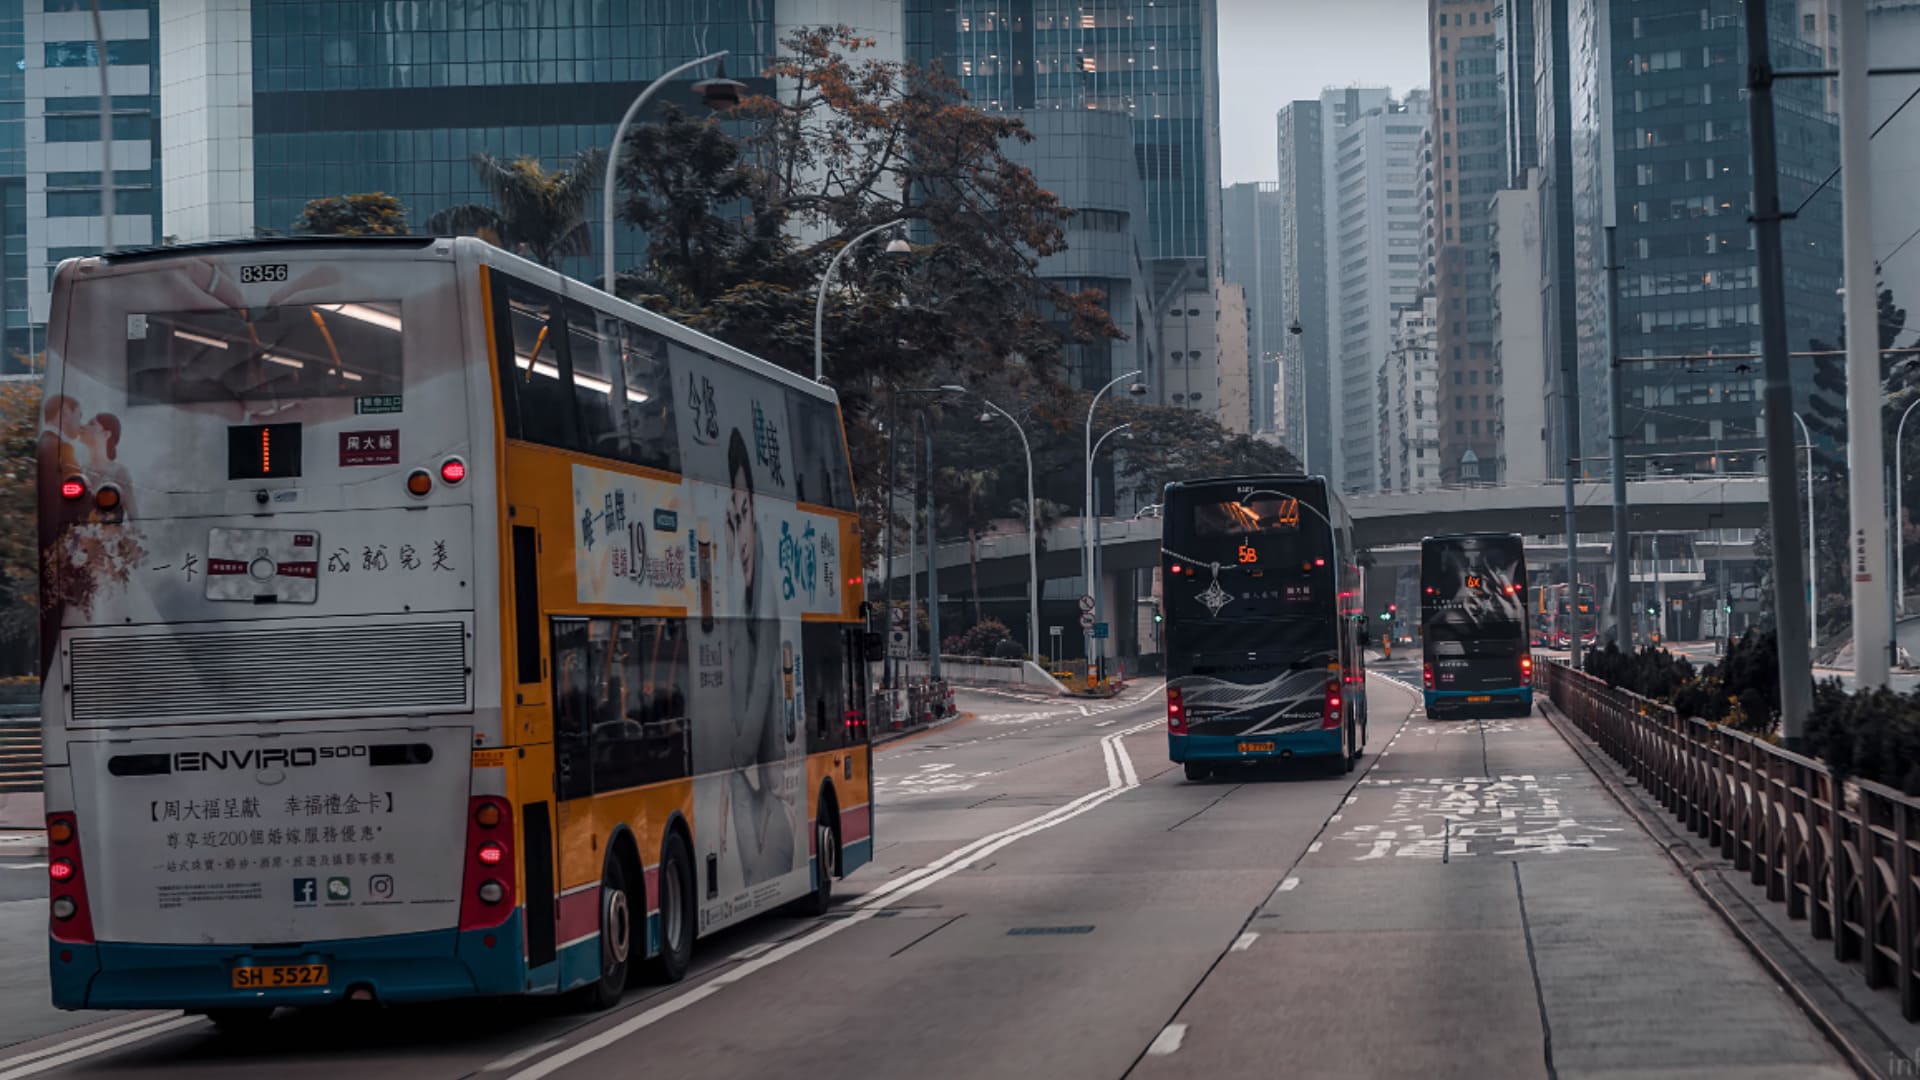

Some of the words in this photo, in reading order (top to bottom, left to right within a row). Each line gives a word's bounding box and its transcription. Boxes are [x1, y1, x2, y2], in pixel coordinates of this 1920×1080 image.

[242, 265, 287, 282] 8356
[262, 427, 270, 473] 1
[1238, 544, 1258, 564] 5B
[238, 968, 263, 985] SH
[272, 966, 323, 984] 5527
